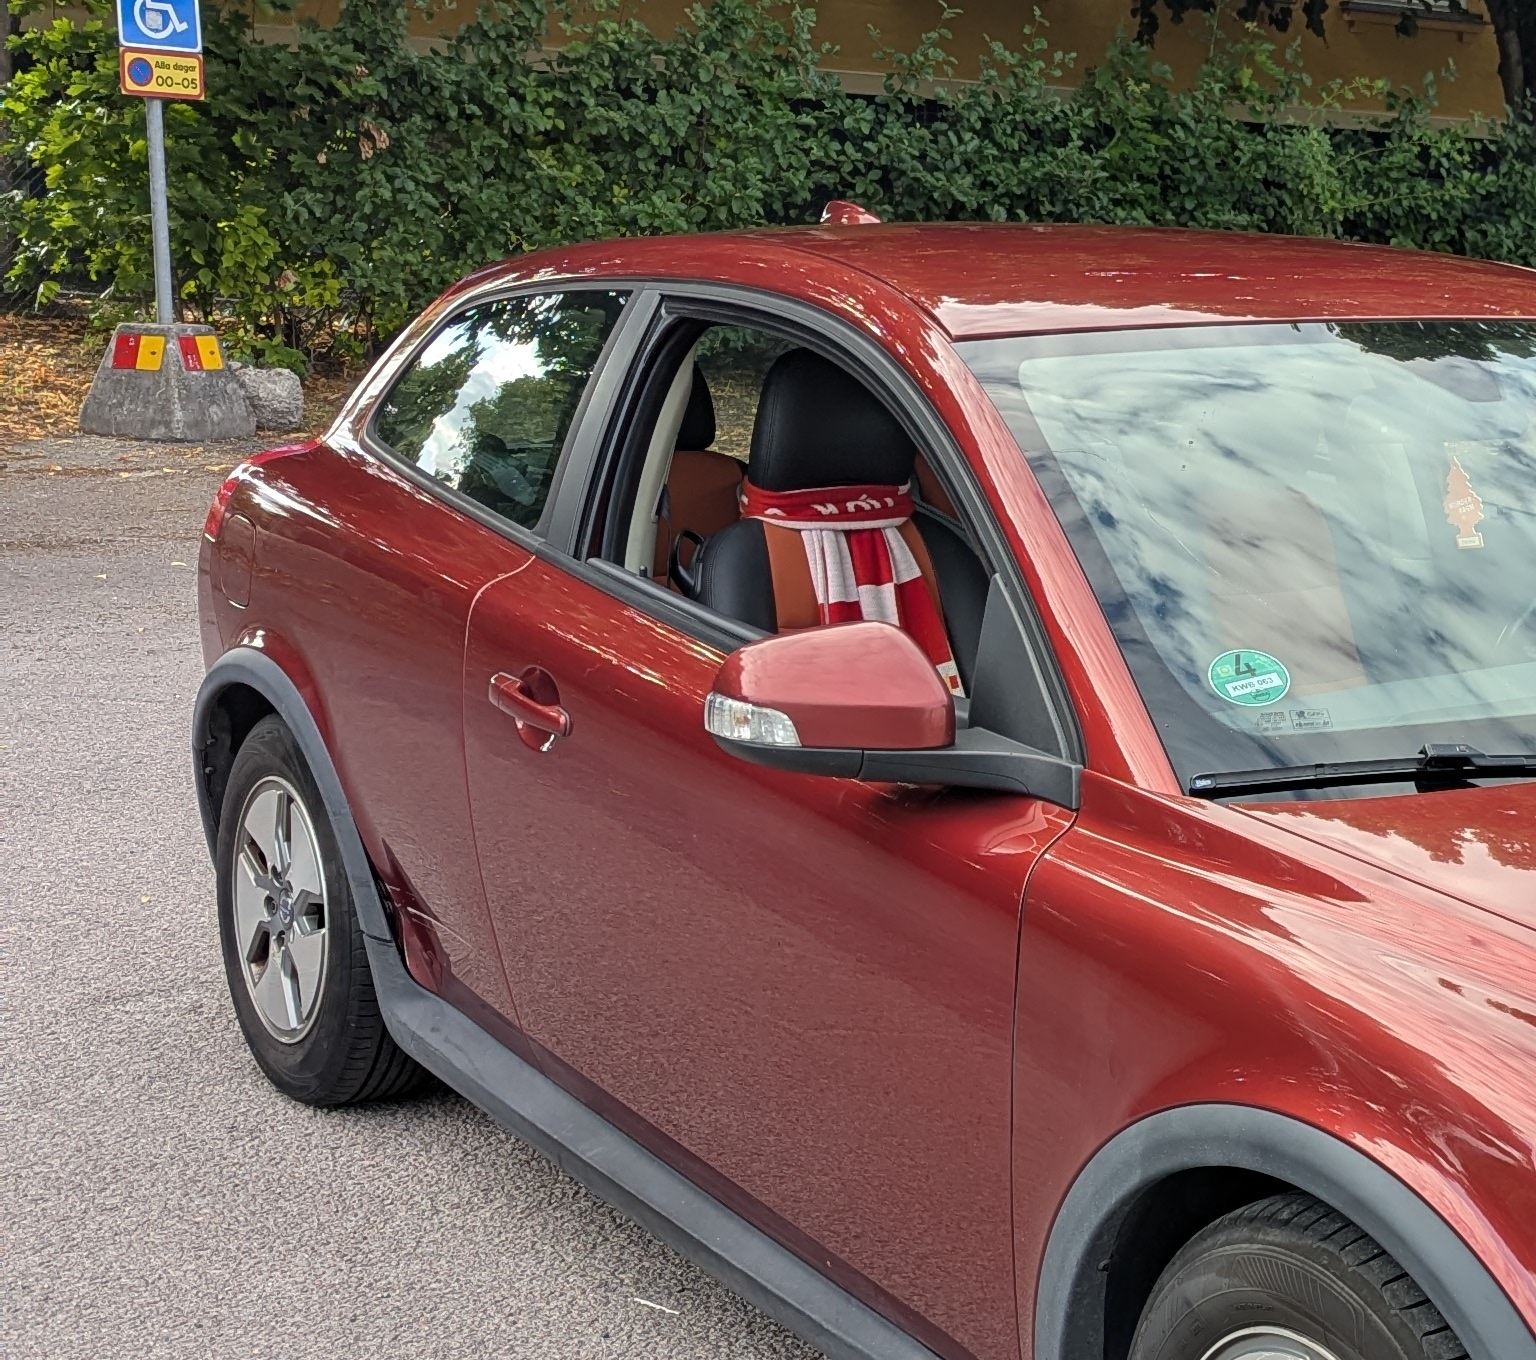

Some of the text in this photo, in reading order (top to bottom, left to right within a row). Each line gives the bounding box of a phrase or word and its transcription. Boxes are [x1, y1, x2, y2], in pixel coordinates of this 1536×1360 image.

[173, 61, 197, 73] dagar
[156, 75, 198, 90] 00-05
[1235, 653, 1256, 676] 4
[1231, 681, 1256, 692] KWB
